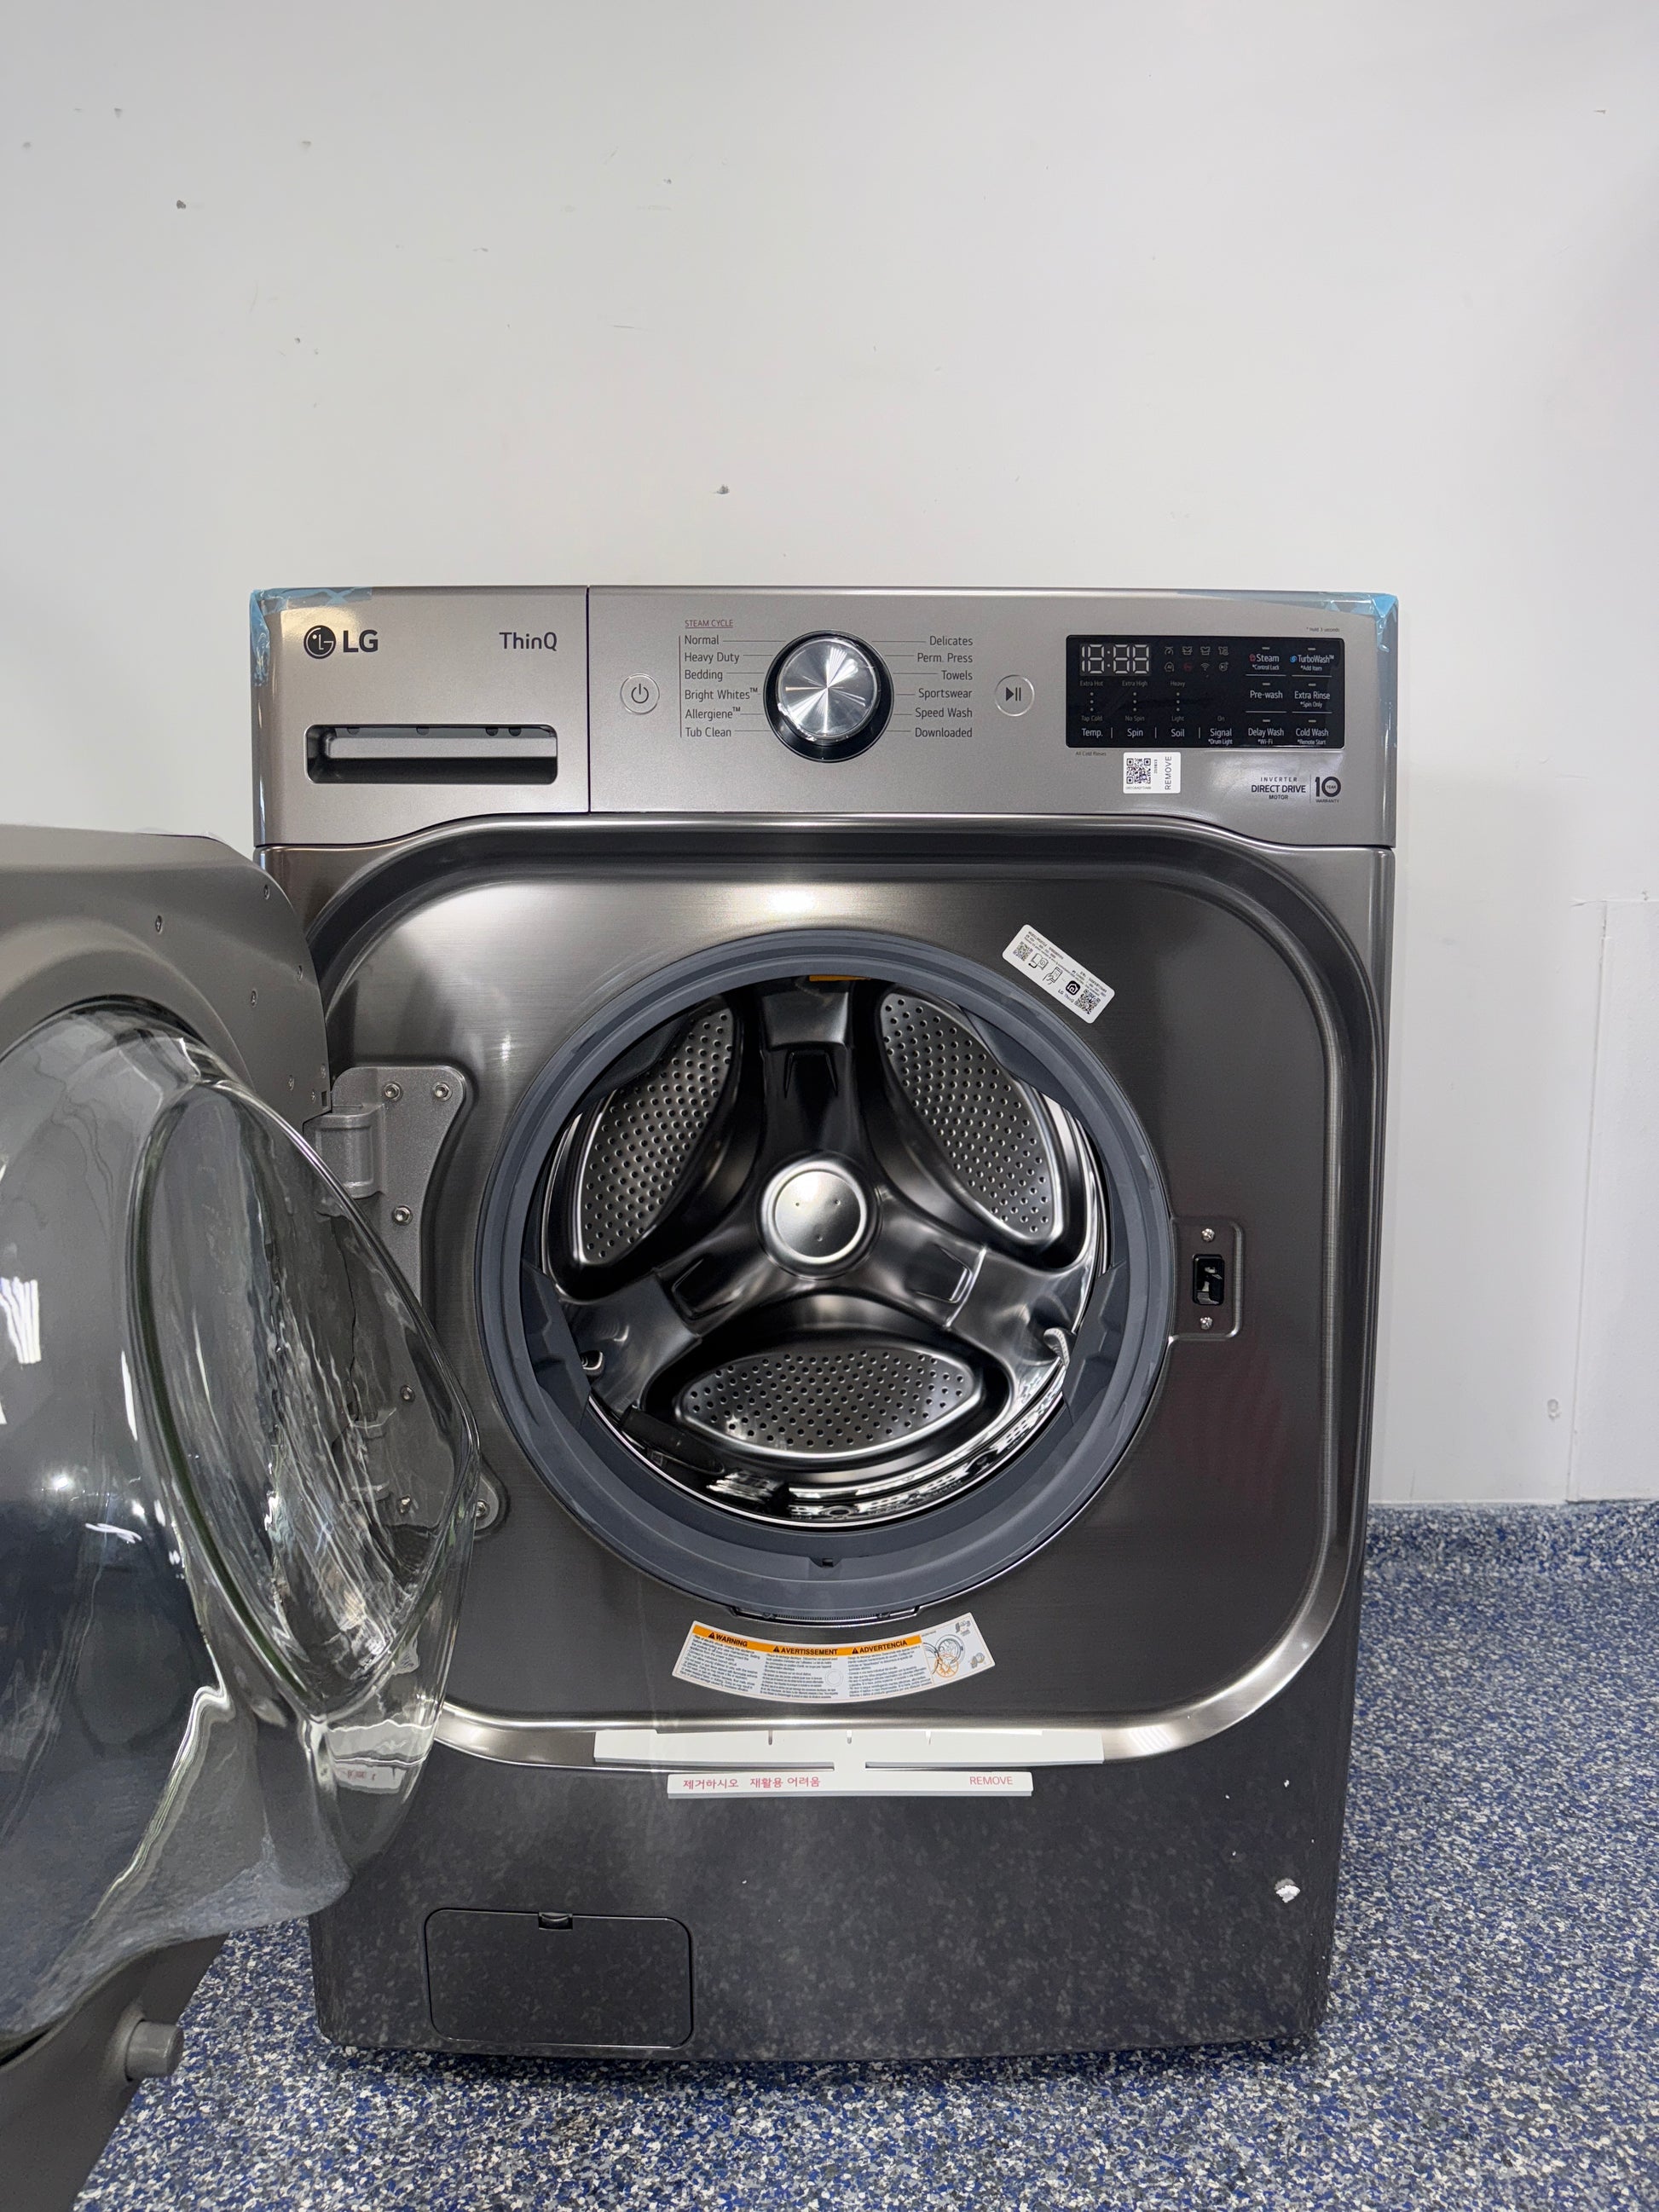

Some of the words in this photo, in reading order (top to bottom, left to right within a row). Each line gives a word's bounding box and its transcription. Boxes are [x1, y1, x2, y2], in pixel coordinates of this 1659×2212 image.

[685, 619, 709, 627] STEAM
[711, 619, 733, 627] CYCLE
[343, 629, 379, 653] LG
[499, 632, 558, 651] ThinQ
[685, 635, 720, 644] Normal
[929, 636, 974, 646] Delicates
[685, 652, 714, 665] Heavy
[717, 652, 740, 665] Duty
[917, 652, 944, 662] Perm.
[947, 653, 974, 663] Press
[1257, 654, 1280, 662] Steam
[685, 669, 723, 682] Bedding
[941, 670, 973, 680] Towels
[685, 690, 714, 702] Bright
[918, 688, 973, 701] Sportswear
[1250, 690, 1283, 699] Pre-wash
[1294, 690, 1311, 699] Extra
[915, 707, 945, 719] Speed
[947, 707, 973, 718] Wash
[685, 727, 702, 737] Tub
[705, 727, 731, 737] Clean
[915, 727, 973, 737] Downloaded
[1081, 728, 1103, 737] Temp.
[1127, 728, 1144, 737] Spin
[1171, 729, 1185, 737] Soil
[1210, 728, 1232, 738] Signal
[1248, 728, 1266, 738] Delay
[1267, 728, 1284, 736] Wash
[1296, 728, 1310, 736] Cold
[1311, 728, 1329, 736] Wash
[1315, 777, 1342, 798] 10
[715, 1633, 748, 1647] WARNING
[859, 1640, 908, 1654] ADVERTENCIA
[683, 1778, 739, 1790] 제거하시오
[750, 1777, 783, 1788] 재활용
[787, 1776, 821, 1788] 어려움
[969, 1776, 1013, 1785] REMOVE
